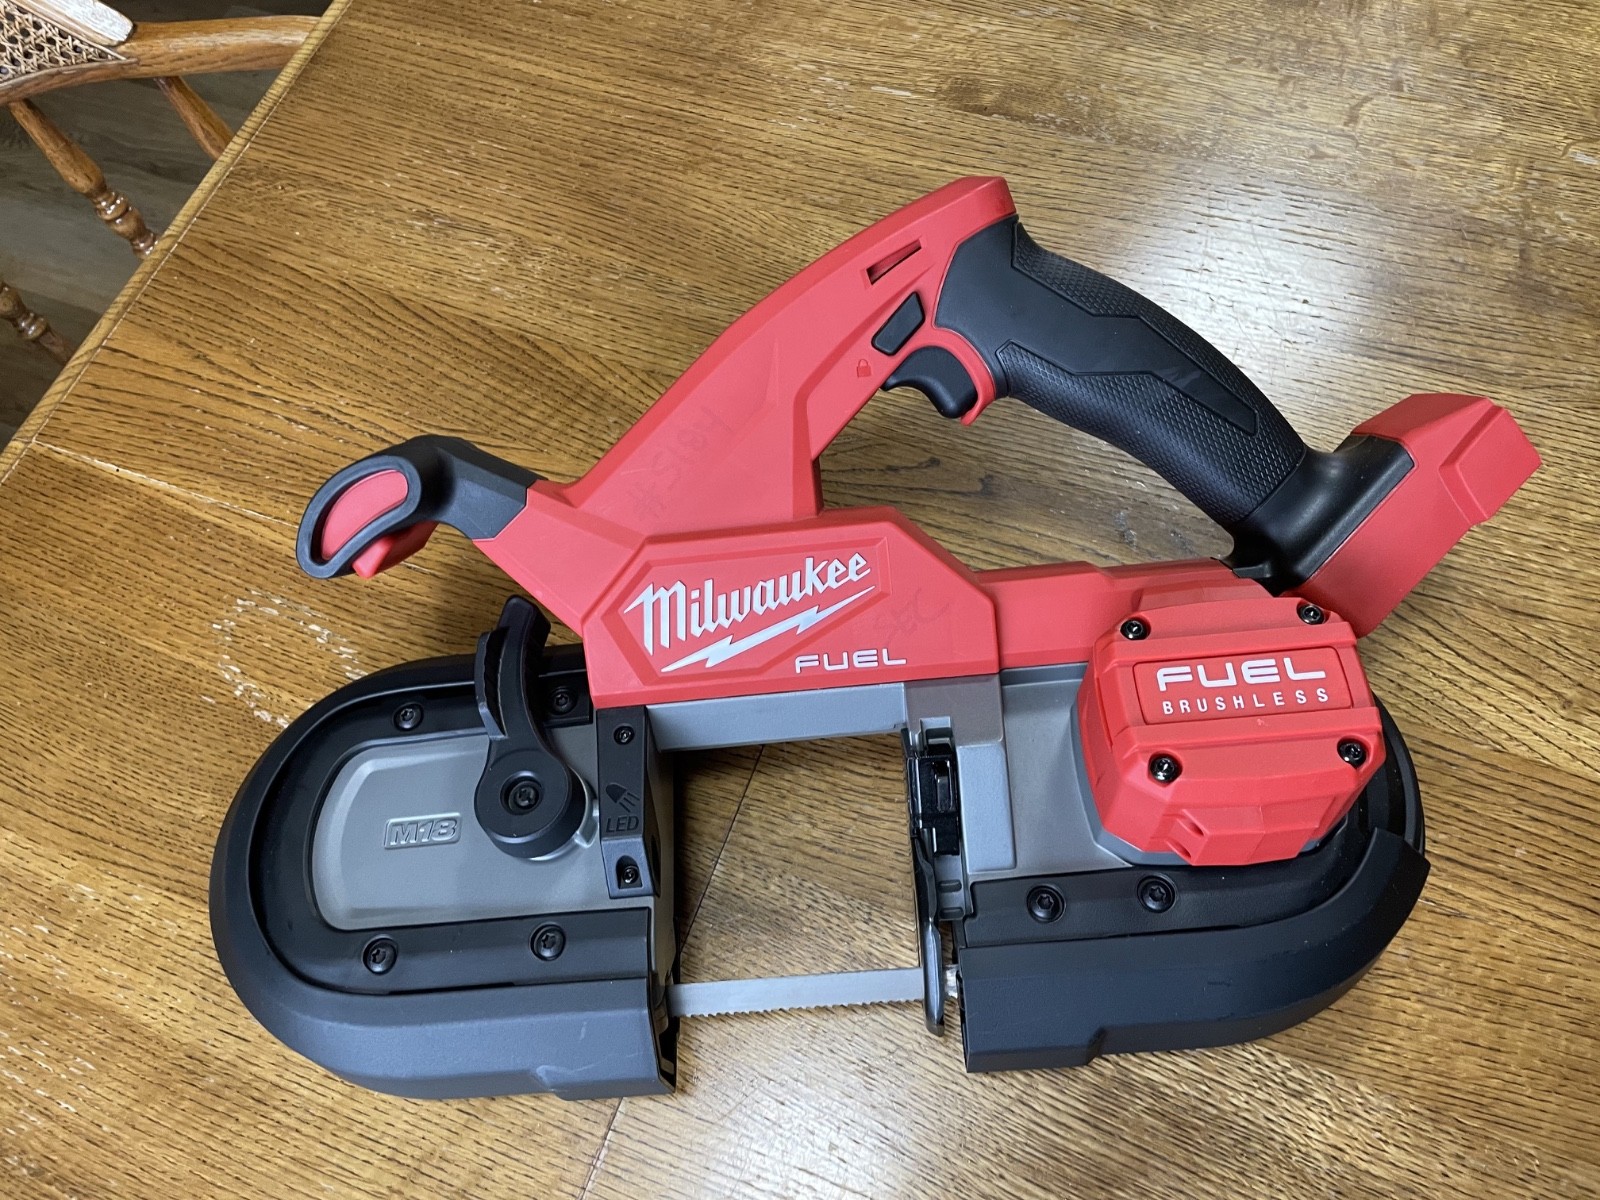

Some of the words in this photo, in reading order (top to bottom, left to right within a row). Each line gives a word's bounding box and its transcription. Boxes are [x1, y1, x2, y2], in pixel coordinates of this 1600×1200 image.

[624, 552, 871, 656] Milwaukee
[795, 648, 907, 673] FUEL
[1156, 657, 1326, 691] FUEL
[1163, 688, 1329, 715] BRUSHLESS
[389, 818, 457, 846] M18
[605, 815, 639, 833] LED
